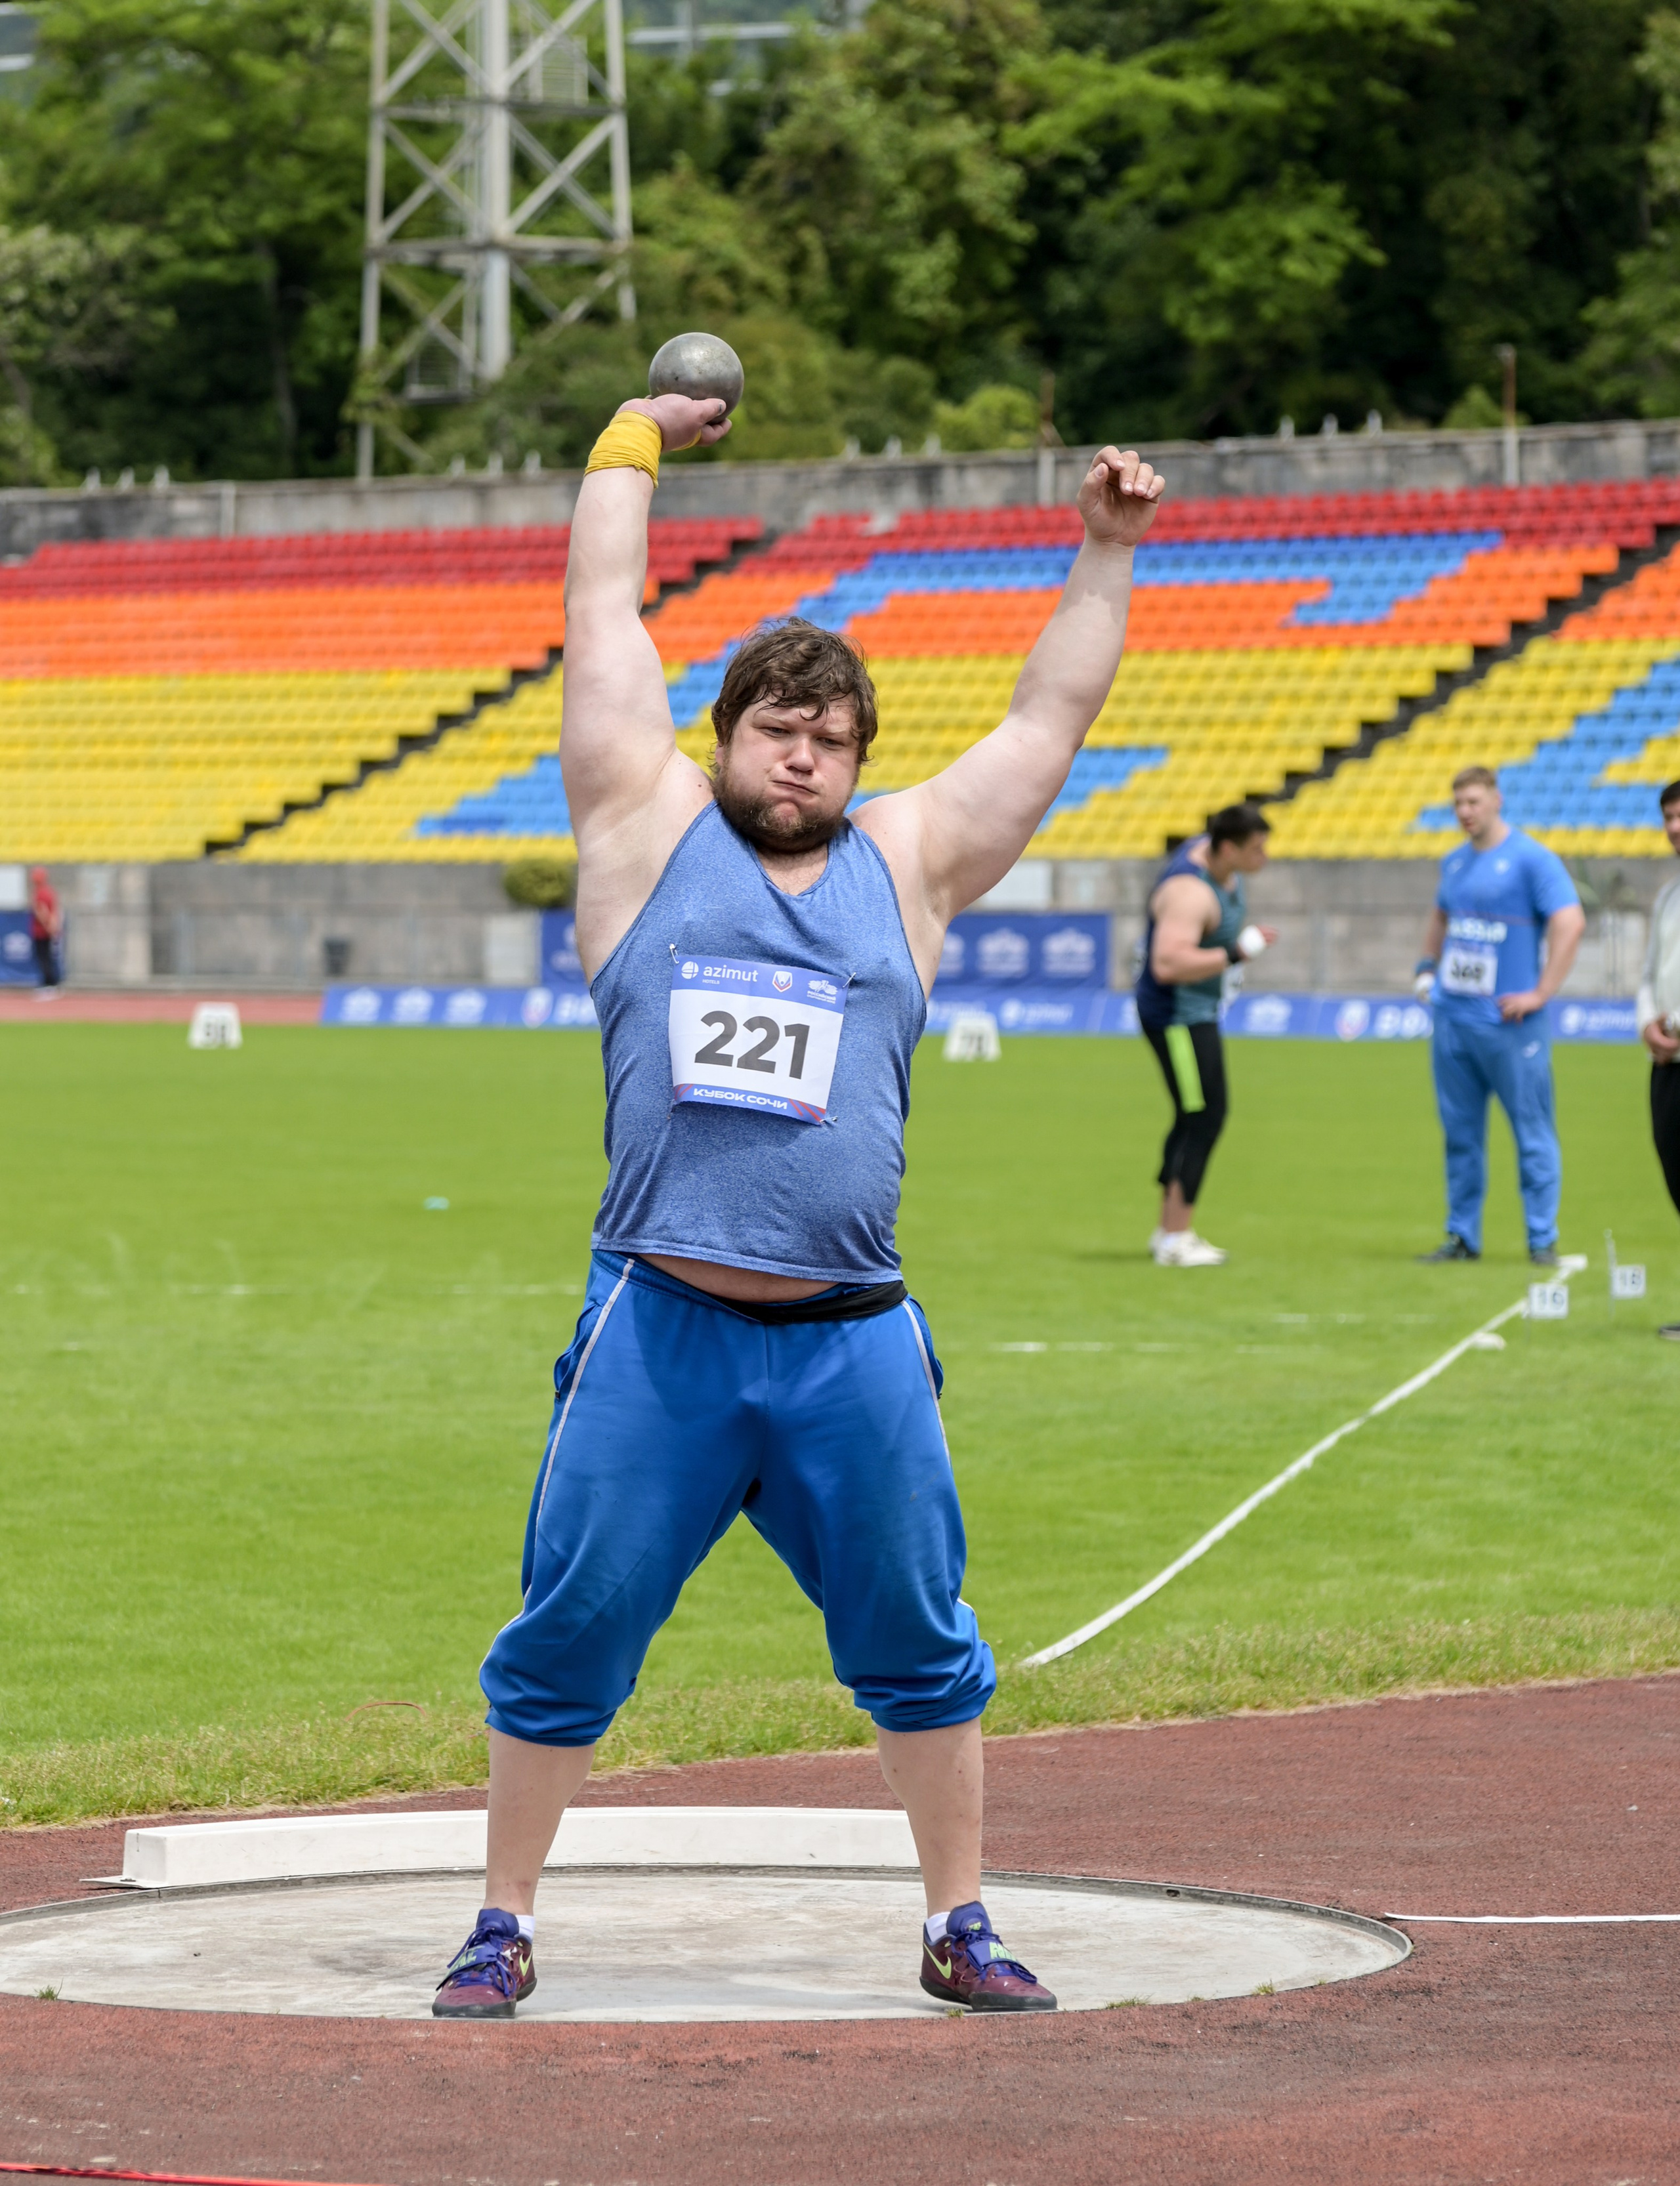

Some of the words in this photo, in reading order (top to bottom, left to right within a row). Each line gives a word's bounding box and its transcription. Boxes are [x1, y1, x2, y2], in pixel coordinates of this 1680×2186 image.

[703, 965, 759, 982] azimut
[694, 1010, 810, 1080] 221
[693, 1087, 746, 1103] КУБОК
[747, 1095, 788, 1110] СОЧИ
[1538, 1288, 1565, 1311] 16
